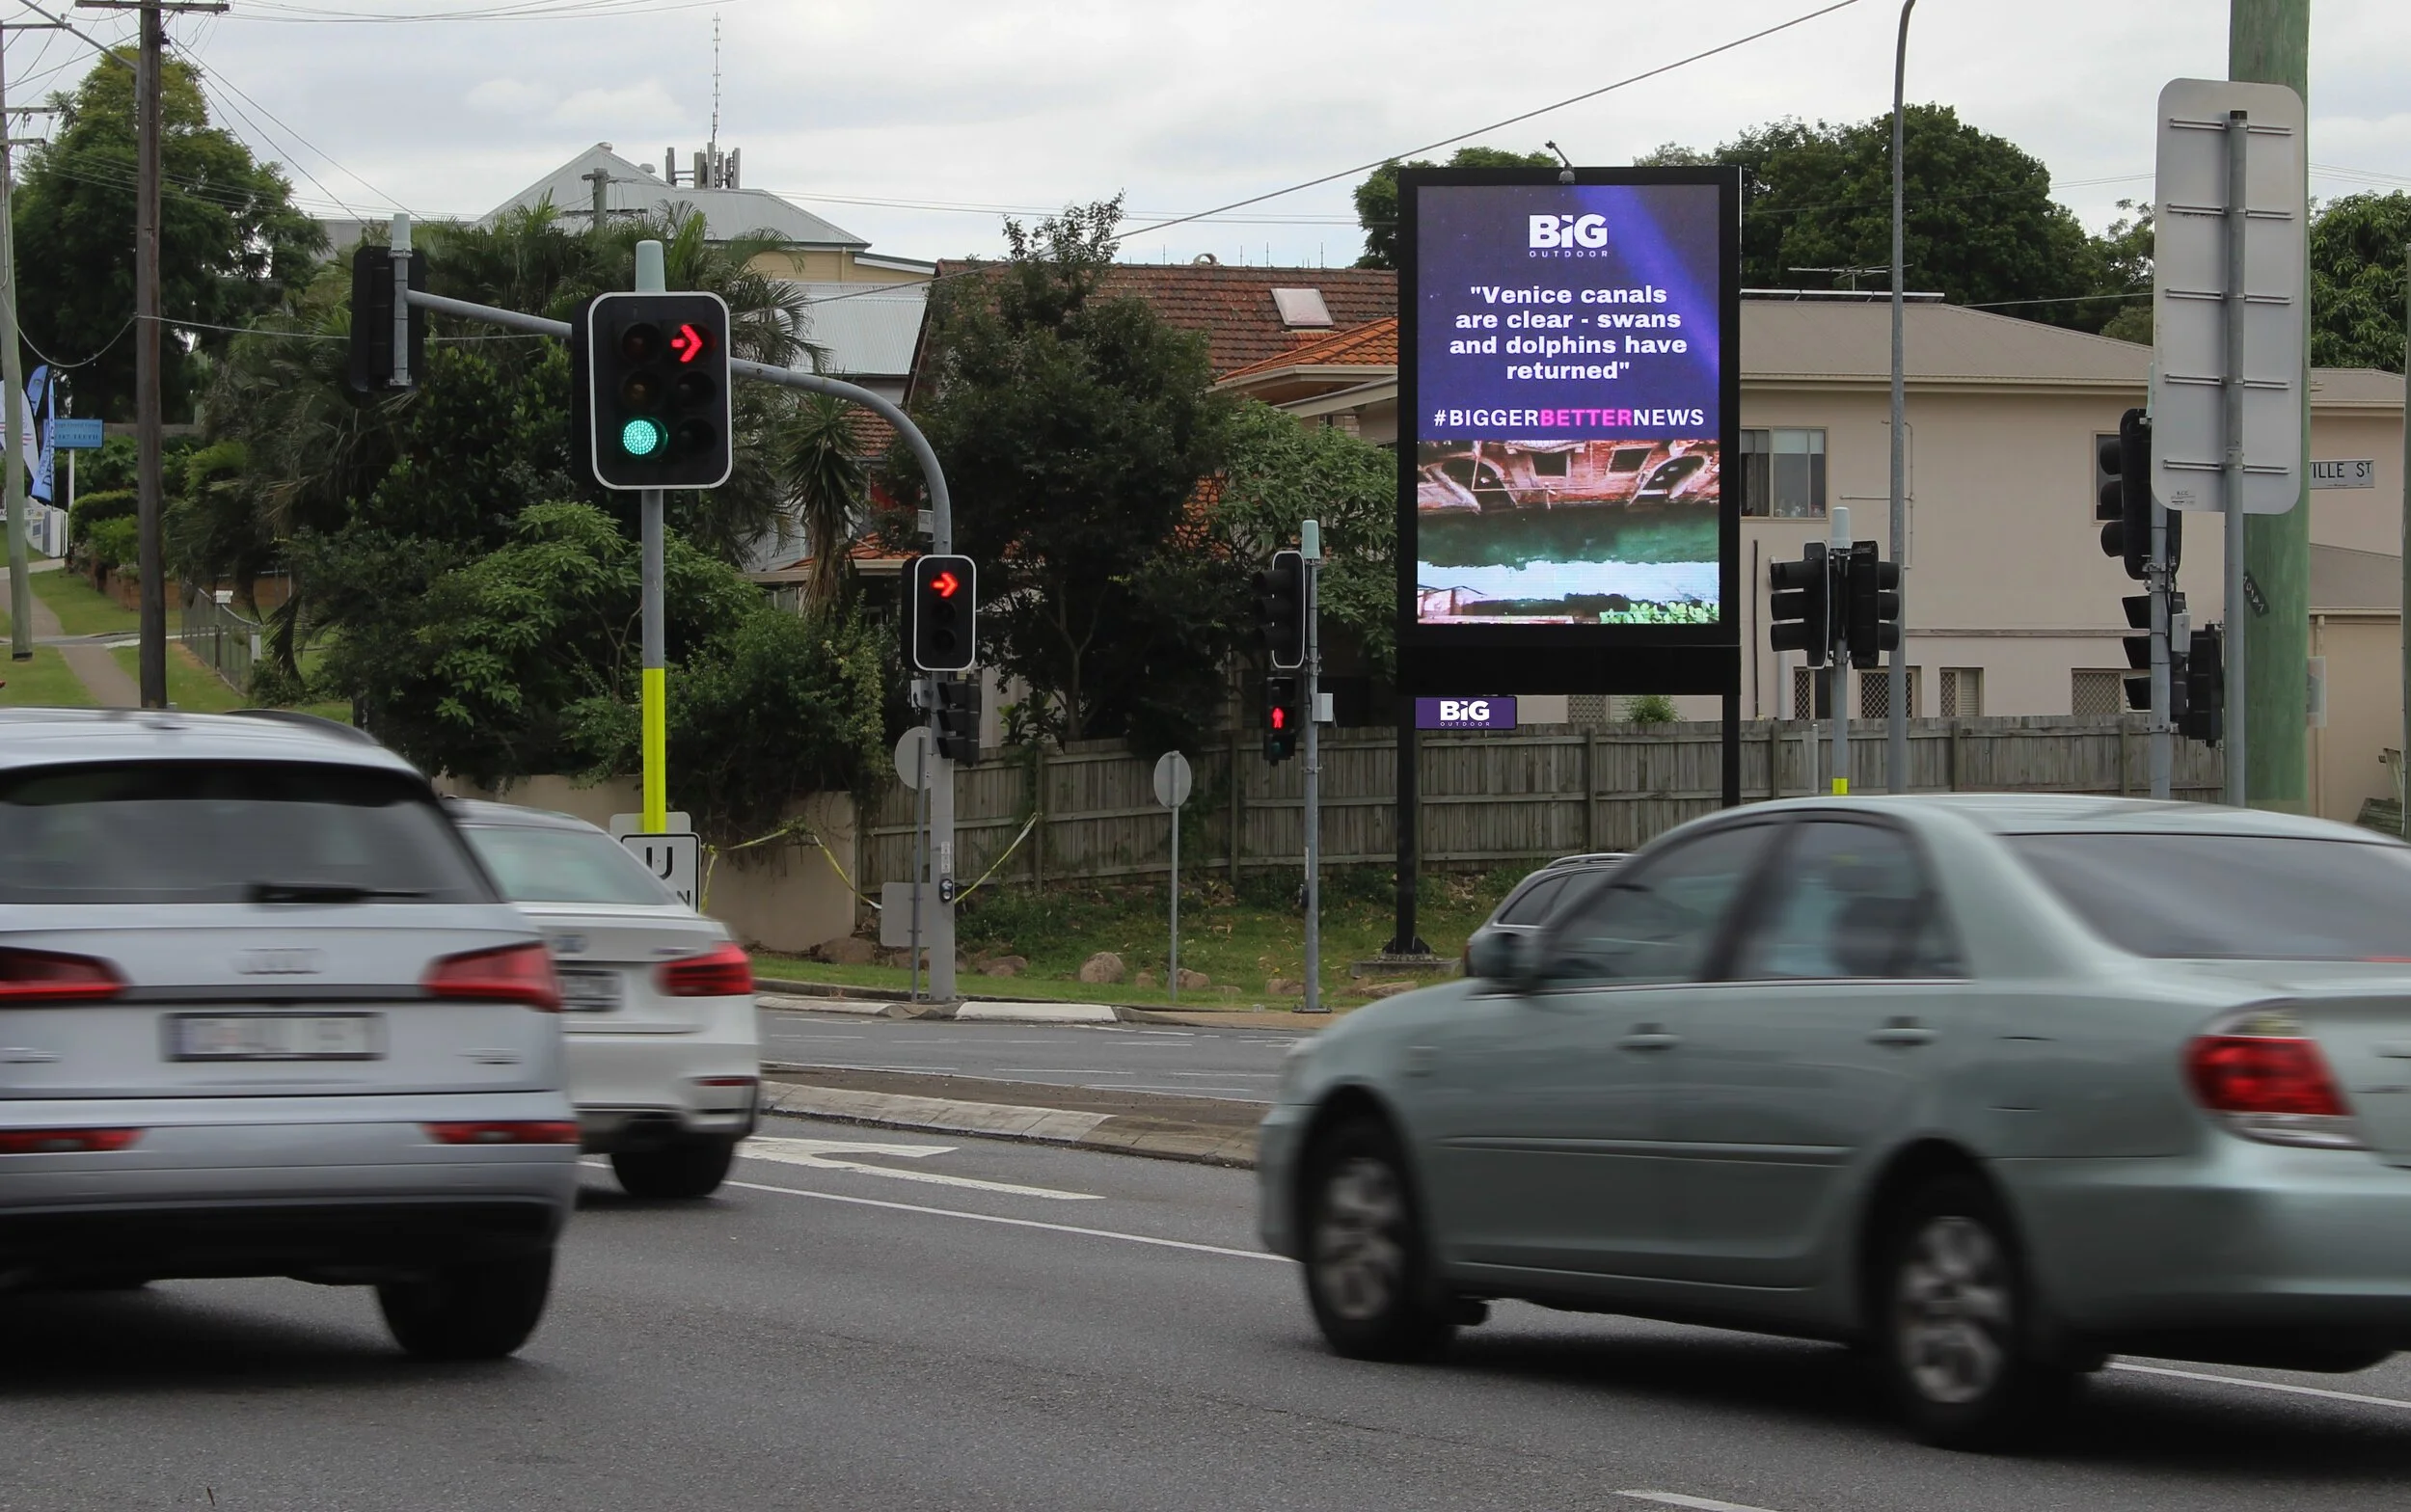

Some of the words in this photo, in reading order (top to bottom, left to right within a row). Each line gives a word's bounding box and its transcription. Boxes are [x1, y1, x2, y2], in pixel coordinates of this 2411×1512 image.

[1470, 285, 1572, 304] "Venice
[1580, 285, 1667, 304] canals
[1454, 313, 1498, 329] are
[1506, 310, 1573, 329] clear
[1597, 313, 1681, 329] swans
[1449, 337, 1497, 354] and
[1505, 337, 1616, 358] dolphins
[1624, 336, 1688, 354] have
[1506, 362, 1631, 380] returned"
[1433, 409, 1705, 426] #BIGGERBETTERNEWS
[2309, 462, 2345, 478] ILLE
[2356, 462, 2372, 478] ST
